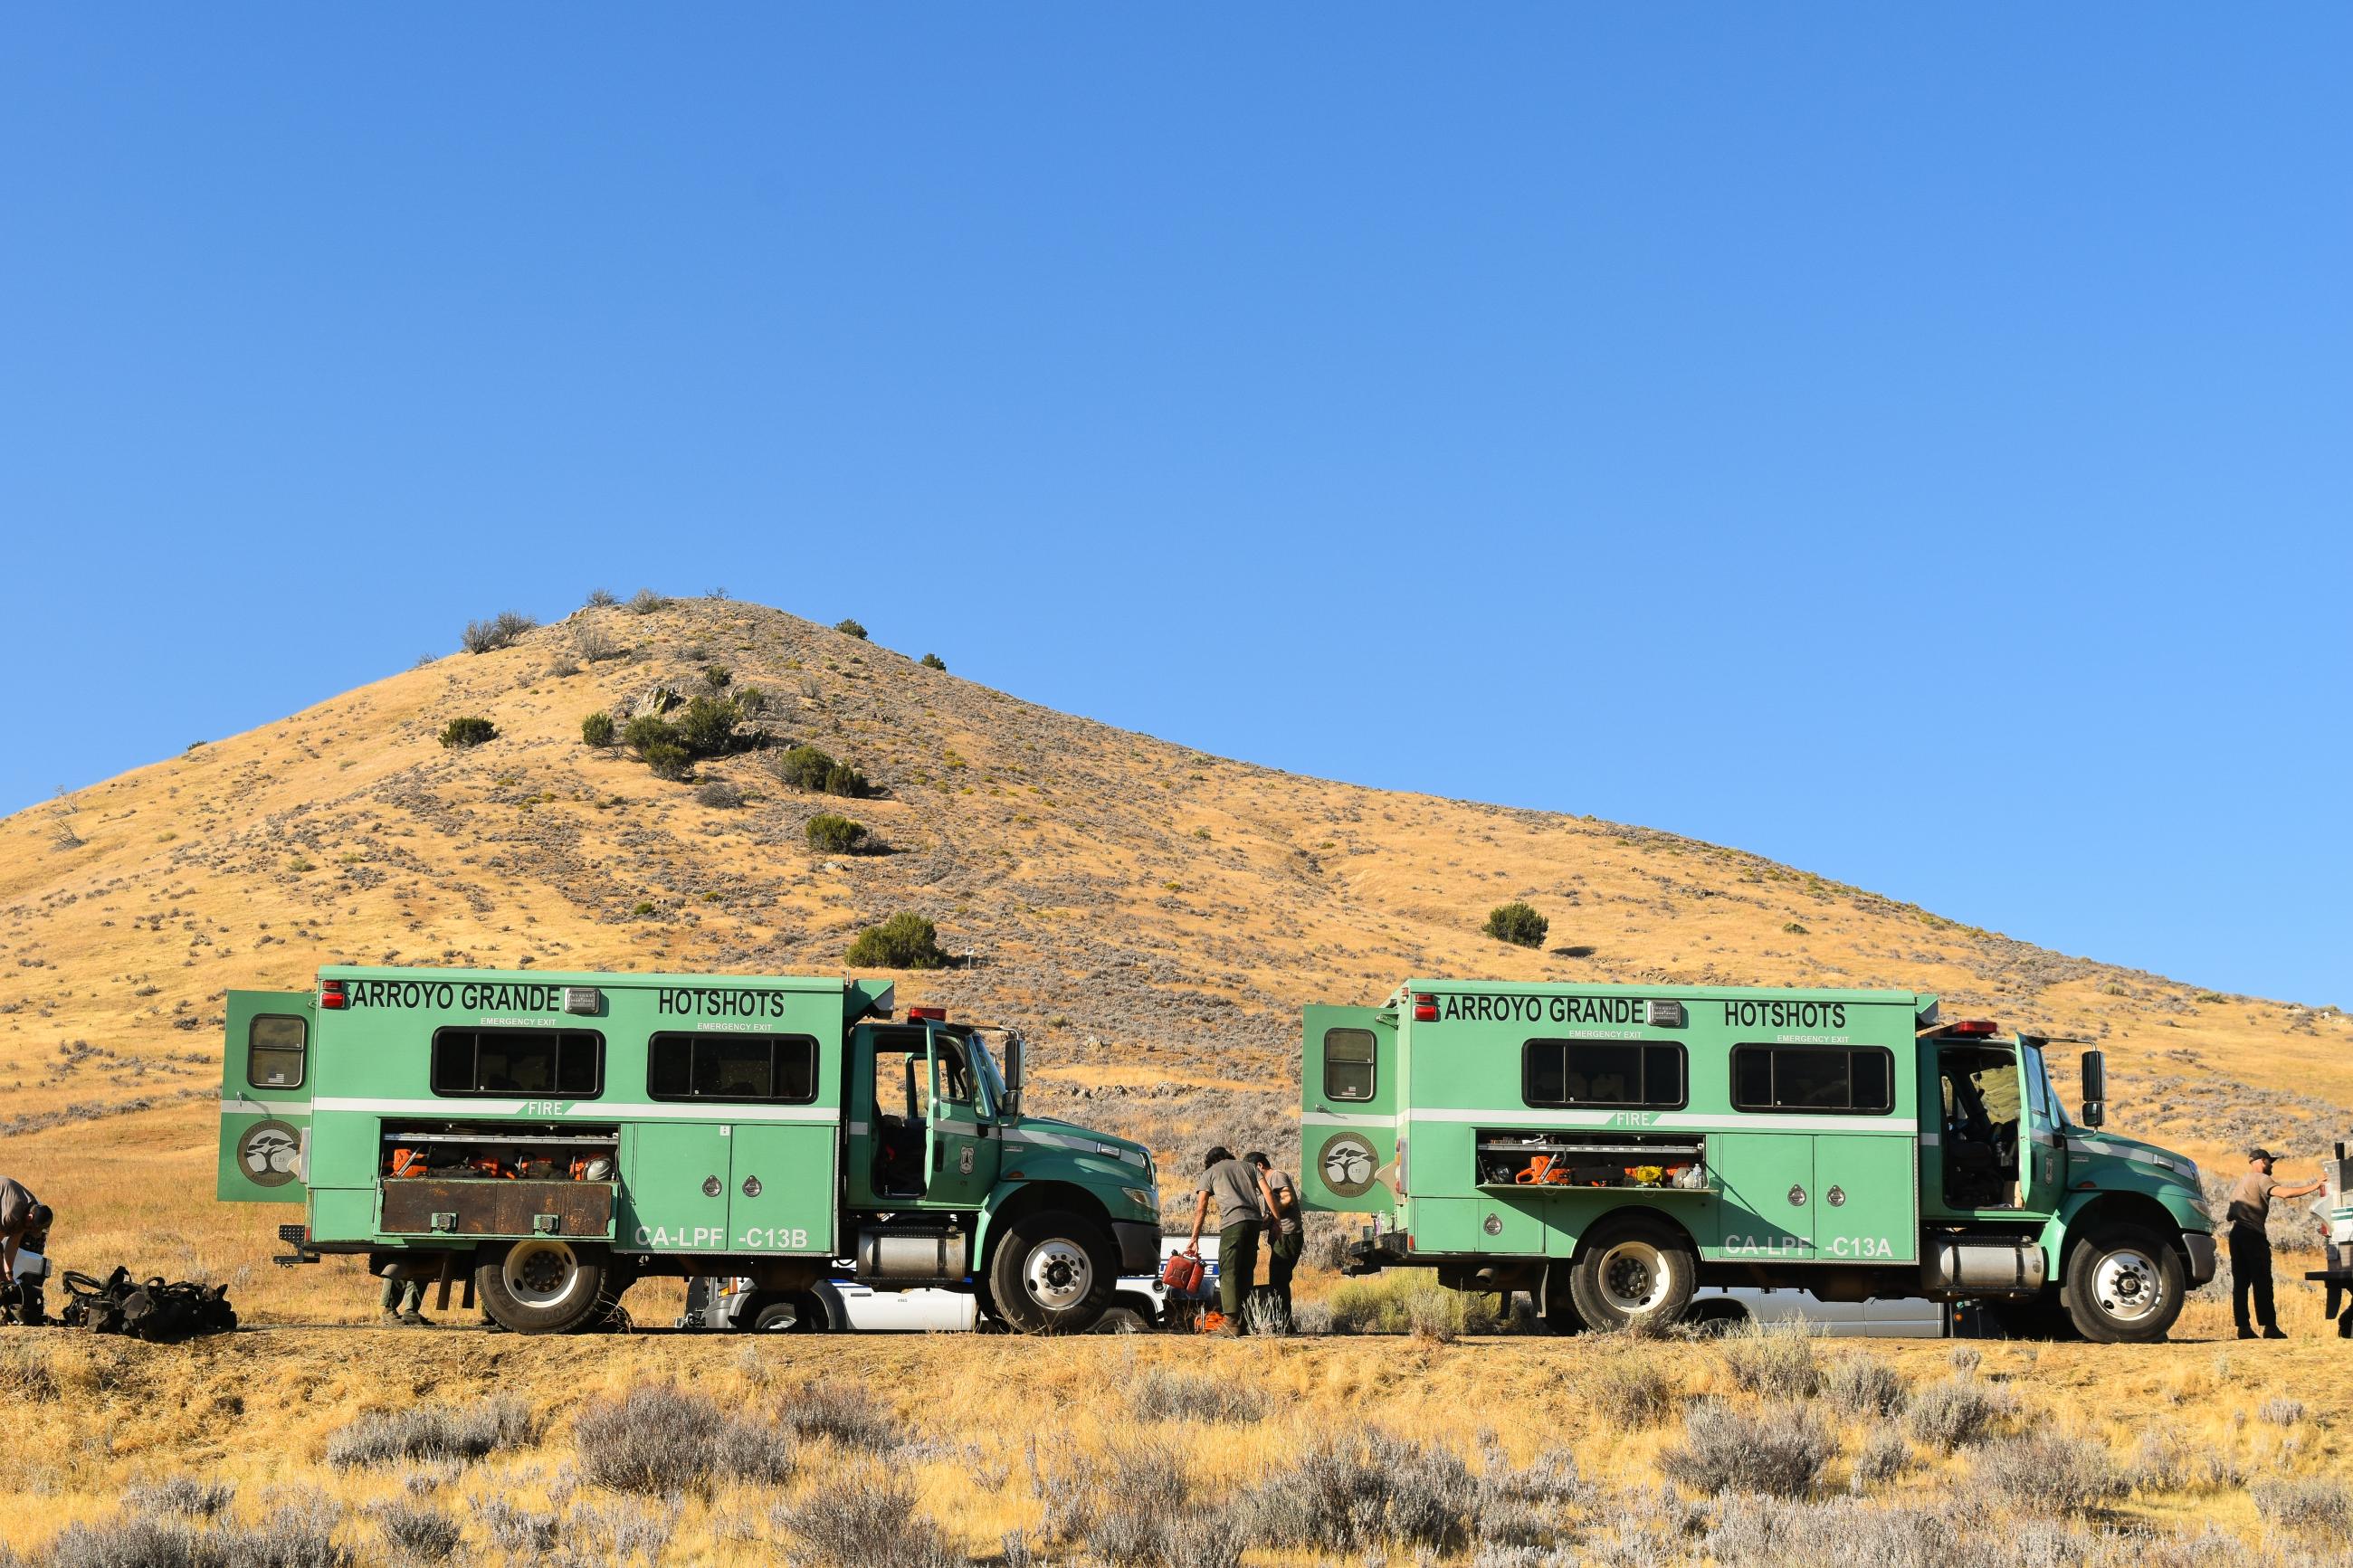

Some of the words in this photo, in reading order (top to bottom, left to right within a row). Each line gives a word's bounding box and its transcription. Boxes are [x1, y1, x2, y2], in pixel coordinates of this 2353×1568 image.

[352, 983, 453, 1009] ARROYO
[462, 984, 560, 1012] GRANDE
[659, 989, 785, 1018] HOTSHOTS
[1444, 995, 1542, 1022] ARROYO
[1549, 997, 1644, 1024] GRANDE
[1725, 1002, 1845, 1029] HOTSHOTS
[481, 1017, 536, 1027] EMERGENCY
[538, 1018, 557, 1027] EXIT
[697, 1022, 751, 1031] EMERGENCY
[753, 1023, 773, 1031] EXIT
[1569, 1030, 1622, 1039] EMERGENCY
[1624, 1031, 1643, 1040] EXIT
[1777, 1034, 1830, 1043] EMERGENCY
[1831, 1035, 1850, 1043] EXIT
[529, 1101, 563, 1116] FIRE
[1616, 1112, 1651, 1126] FIRE
[635, 1226, 724, 1247] CA-LPF
[738, 1227, 807, 1249] -C13B
[1725, 1234, 1811, 1256] CA-LPF
[1825, 1236, 1893, 1257] -C13A
